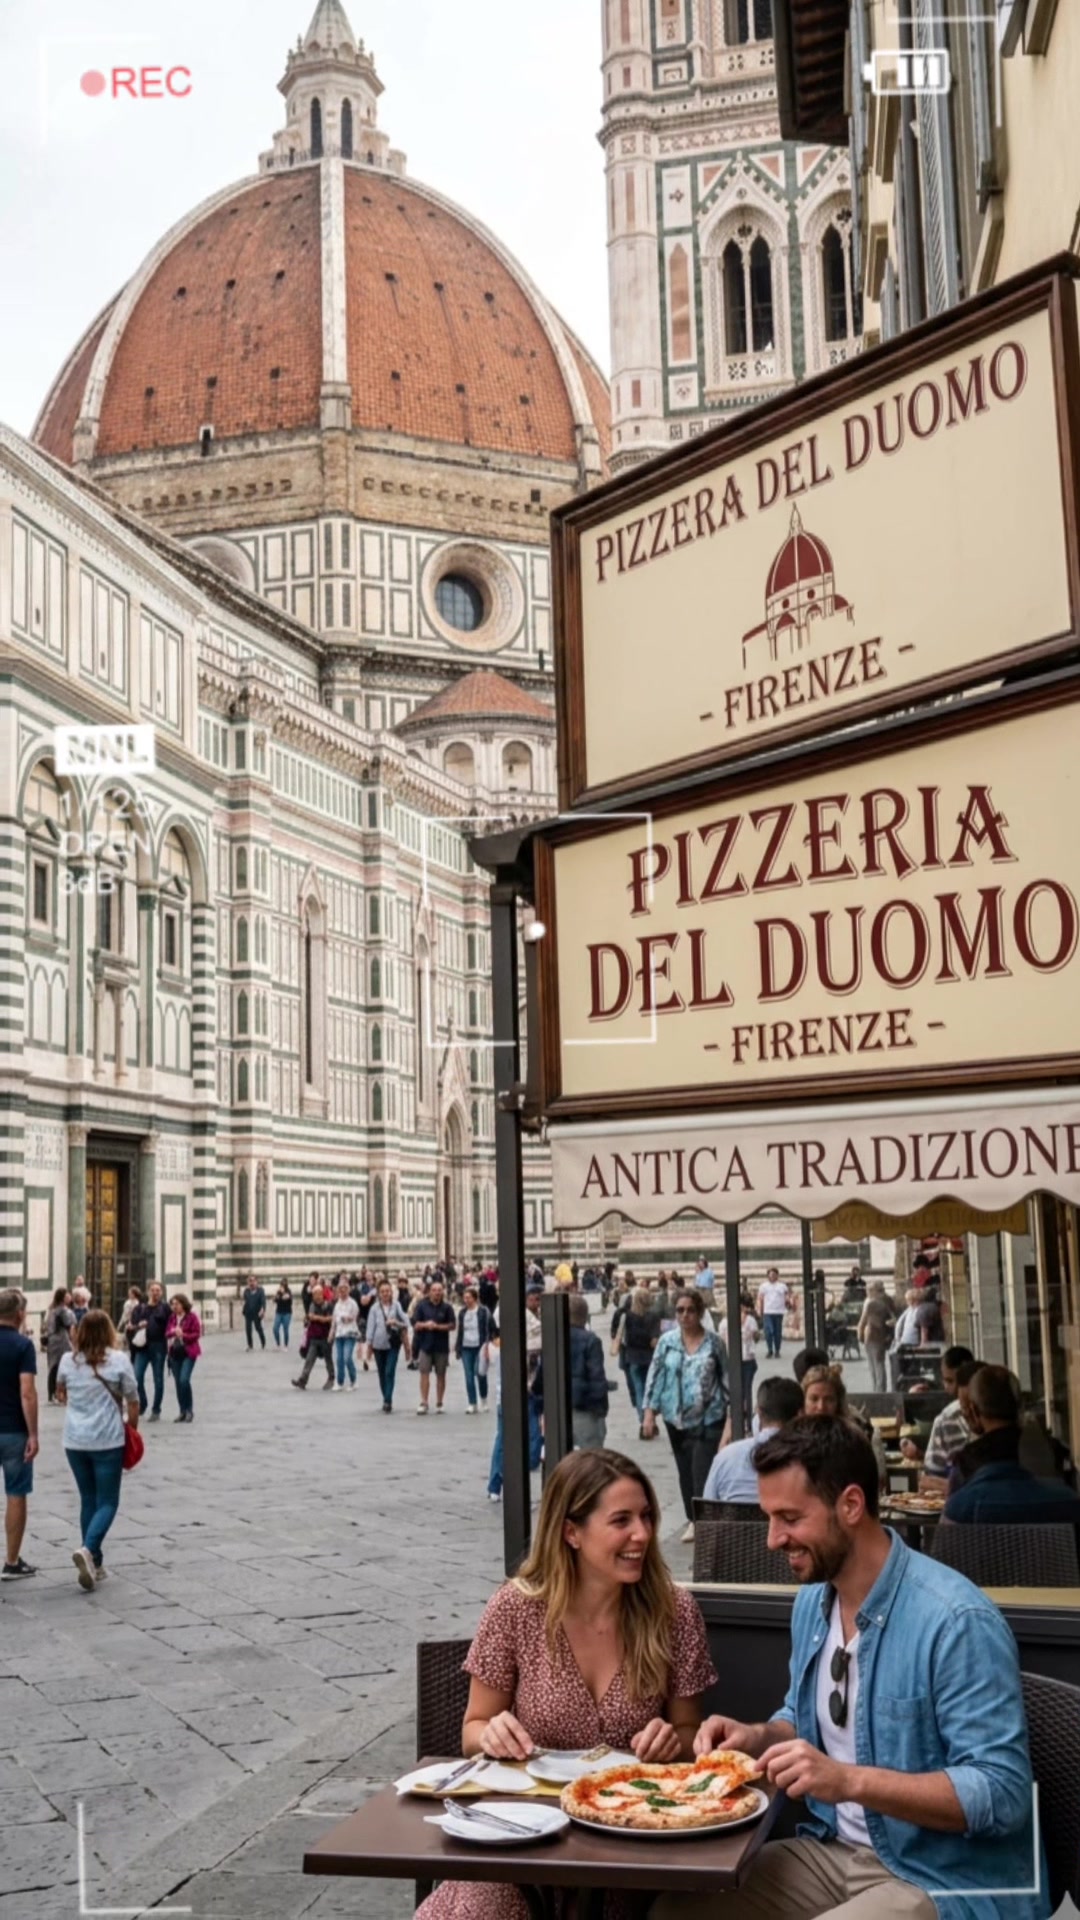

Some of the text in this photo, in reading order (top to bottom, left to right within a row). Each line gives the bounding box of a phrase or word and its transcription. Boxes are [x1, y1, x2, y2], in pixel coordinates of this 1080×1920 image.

[596, 341, 1028, 585] PIZZERA DEL DUOMO
[724, 636, 887, 729] FIRENZE
[626, 784, 1019, 918] PIZZERIA
[586, 878, 1079, 1023] DEL DUOMO
[731, 1008, 917, 1065] FIRENZE
[580, 1122, 1080, 1199] ANTICA TRADIZIONE
